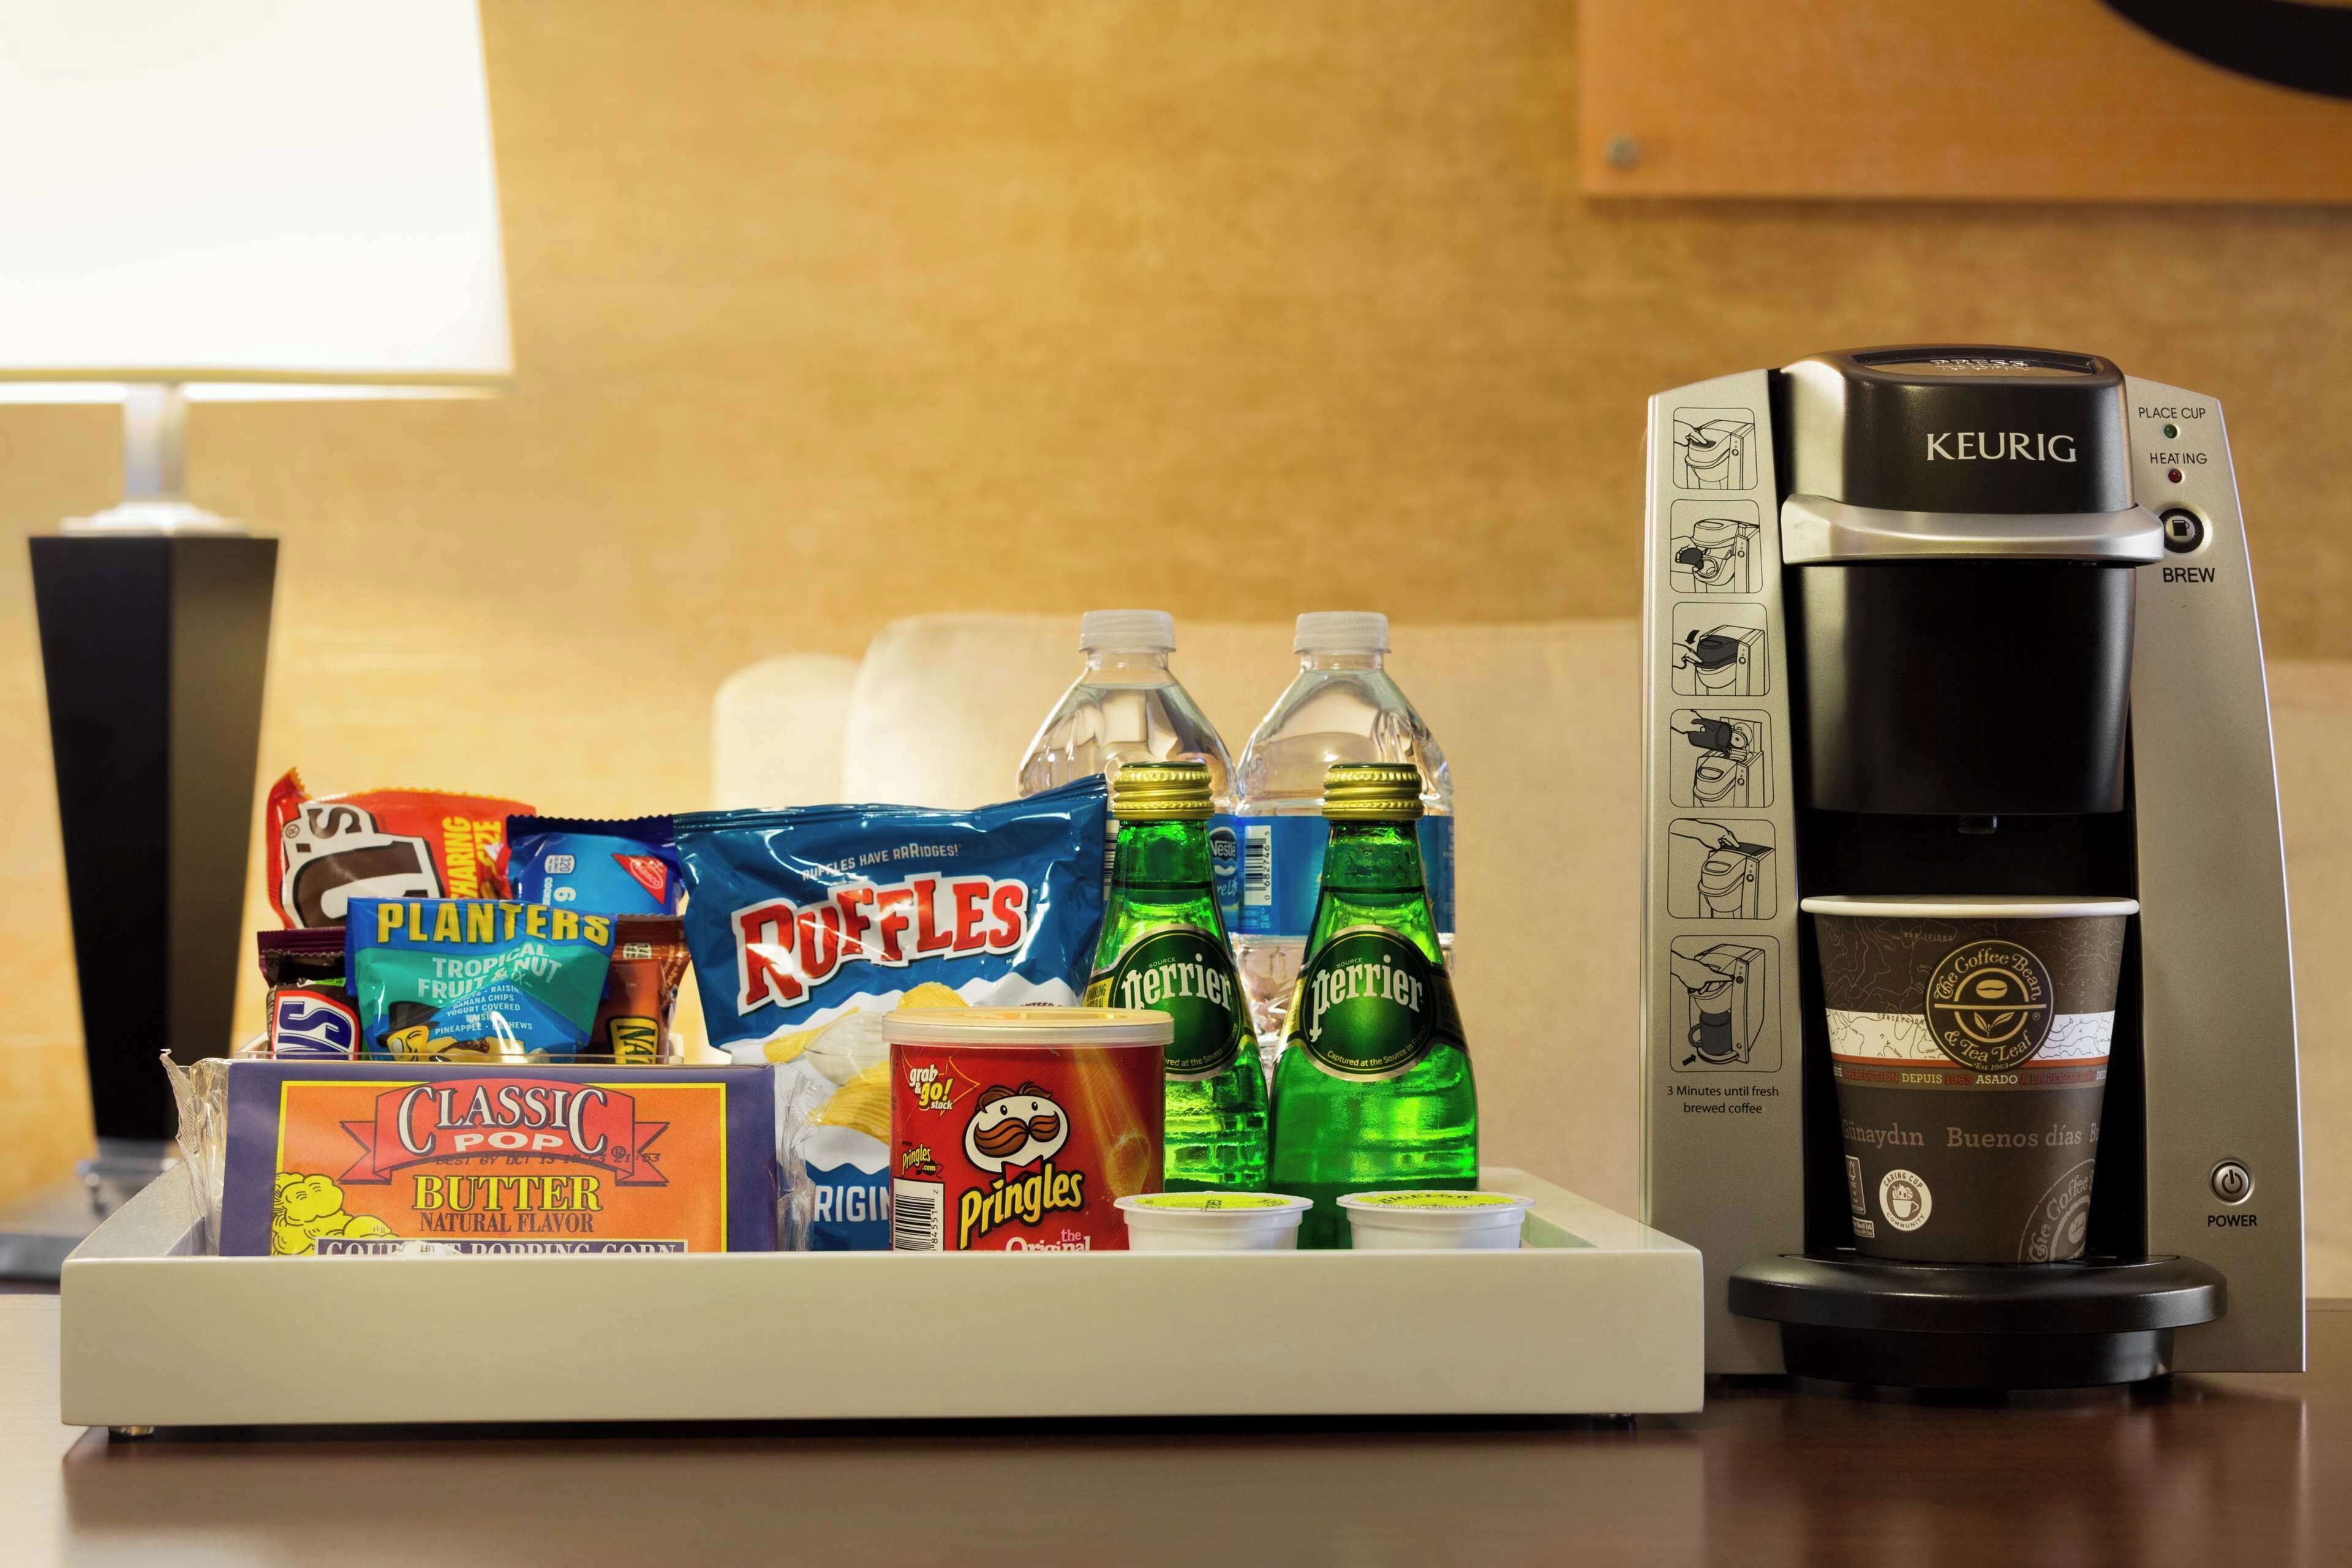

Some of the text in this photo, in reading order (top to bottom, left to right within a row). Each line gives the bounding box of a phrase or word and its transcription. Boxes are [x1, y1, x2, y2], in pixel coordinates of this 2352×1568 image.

[2138, 407, 2206, 419] PLACE CUP
[1927, 432, 2076, 462] KEURIG
[2149, 453, 2207, 464] HEATING
[2163, 567, 2215, 582] BREW
[560, 857, 571, 873] 320
[859, 850, 890, 867] HAVE
[553, 886, 576, 902] 6
[377, 902, 611, 947] PLANTERS
[739, 878, 1025, 1005] RUFFLES
[432, 942, 550, 979] TROPICAL
[1148, 957, 1176, 969] SOURCE
[1336, 957, 1363, 969] SOURCE
[418, 974, 488, 999] FRUIT
[491, 967, 508, 982] &
[513, 956, 563, 984] NUT
[1121, 953, 1231, 1011] perrier
[1934, 948, 2042, 1001] The Coffee Bean
[453, 993, 514, 1010] BANANA CHIPS
[1310, 954, 1423, 1043] perrier
[447, 1003, 521, 1017] YOGURT COVERED
[435, 1022, 482, 1035] PINEAPPLE
[1944, 1030, 2032, 1061] & Tea Leaf
[1191, 1057, 1204, 1066] the
[1203, 1047, 1224, 1063] Source
[1327, 1050, 1359, 1067] Captured
[1370, 1058, 1382, 1066] the
[1383, 1048, 1407, 1064] Source
[1406, 1043, 1414, 1052] in
[909, 1063, 939, 1087] grab
[1974, 1062, 1989, 1071] Est.
[1902, 1072, 1942, 1084] DEPUIS
[1945, 1074, 1973, 1085] 1963
[1976, 1074, 2018, 1084] ASADO
[914, 1077, 954, 1107] & go!
[1667, 1086, 1779, 1096] 3 Minutes until fresh
[930, 1100, 953, 1110] stack
[1684, 1102, 1763, 1113] brewed coffee
[397, 1085, 608, 1156] CLASSIC
[453, 1131, 564, 1152] POP
[1946, 1126, 2038, 1147] Buenos
[2045, 1124, 2082, 1147] días
[480, 1156, 497, 1166] BY
[902, 1142, 932, 1177] Pringles
[1883, 1172, 1923, 1188] CARING CUP
[412, 1175, 603, 1212] BUTTER
[2046, 1174, 2089, 1221] Coffee
[958, 1159, 1084, 1251] Pringles
[420, 1213, 595, 1232] NATURAL FLAVOR
[1887, 1212, 1924, 1228] COMMUNITY
[2207, 1215, 2258, 1227] POWER
[1060, 1229, 1082, 1243] the
